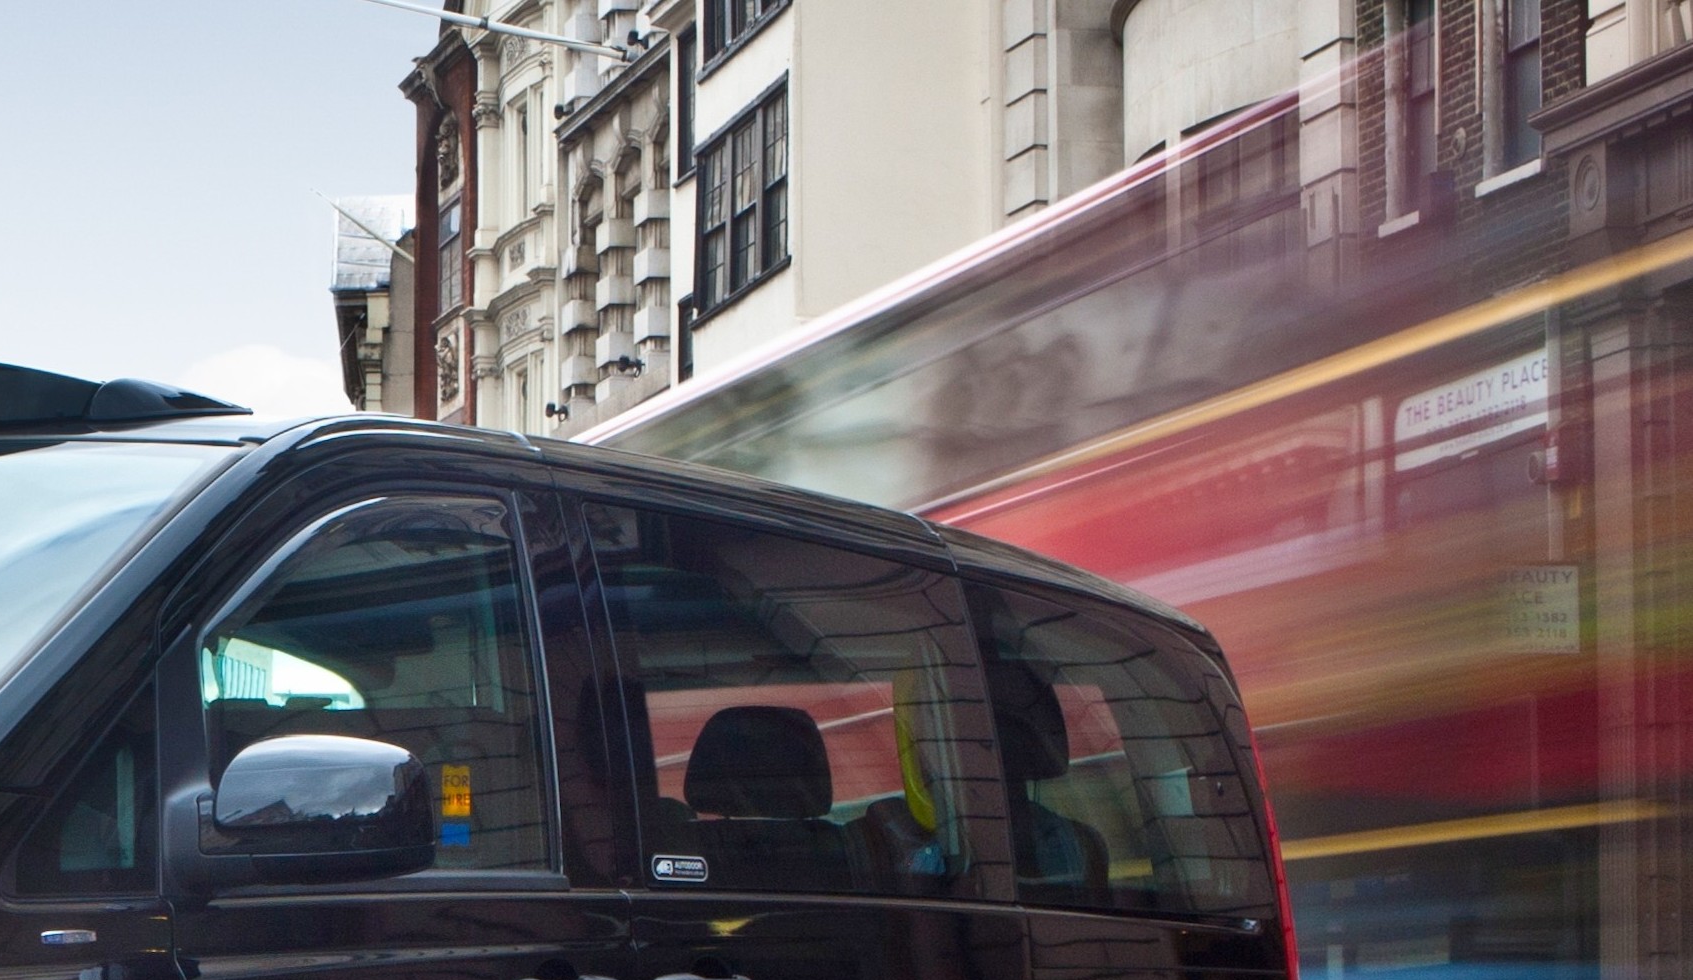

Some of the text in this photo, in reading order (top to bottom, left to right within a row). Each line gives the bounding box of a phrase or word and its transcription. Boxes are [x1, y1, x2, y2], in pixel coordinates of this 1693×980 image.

[1405, 401, 1430, 427] THE
[1437, 377, 1494, 415] BEAUTY
[1501, 358, 1549, 392] PLACE
[444, 775, 469, 787] FOR
[444, 793, 471, 806] HIRE
